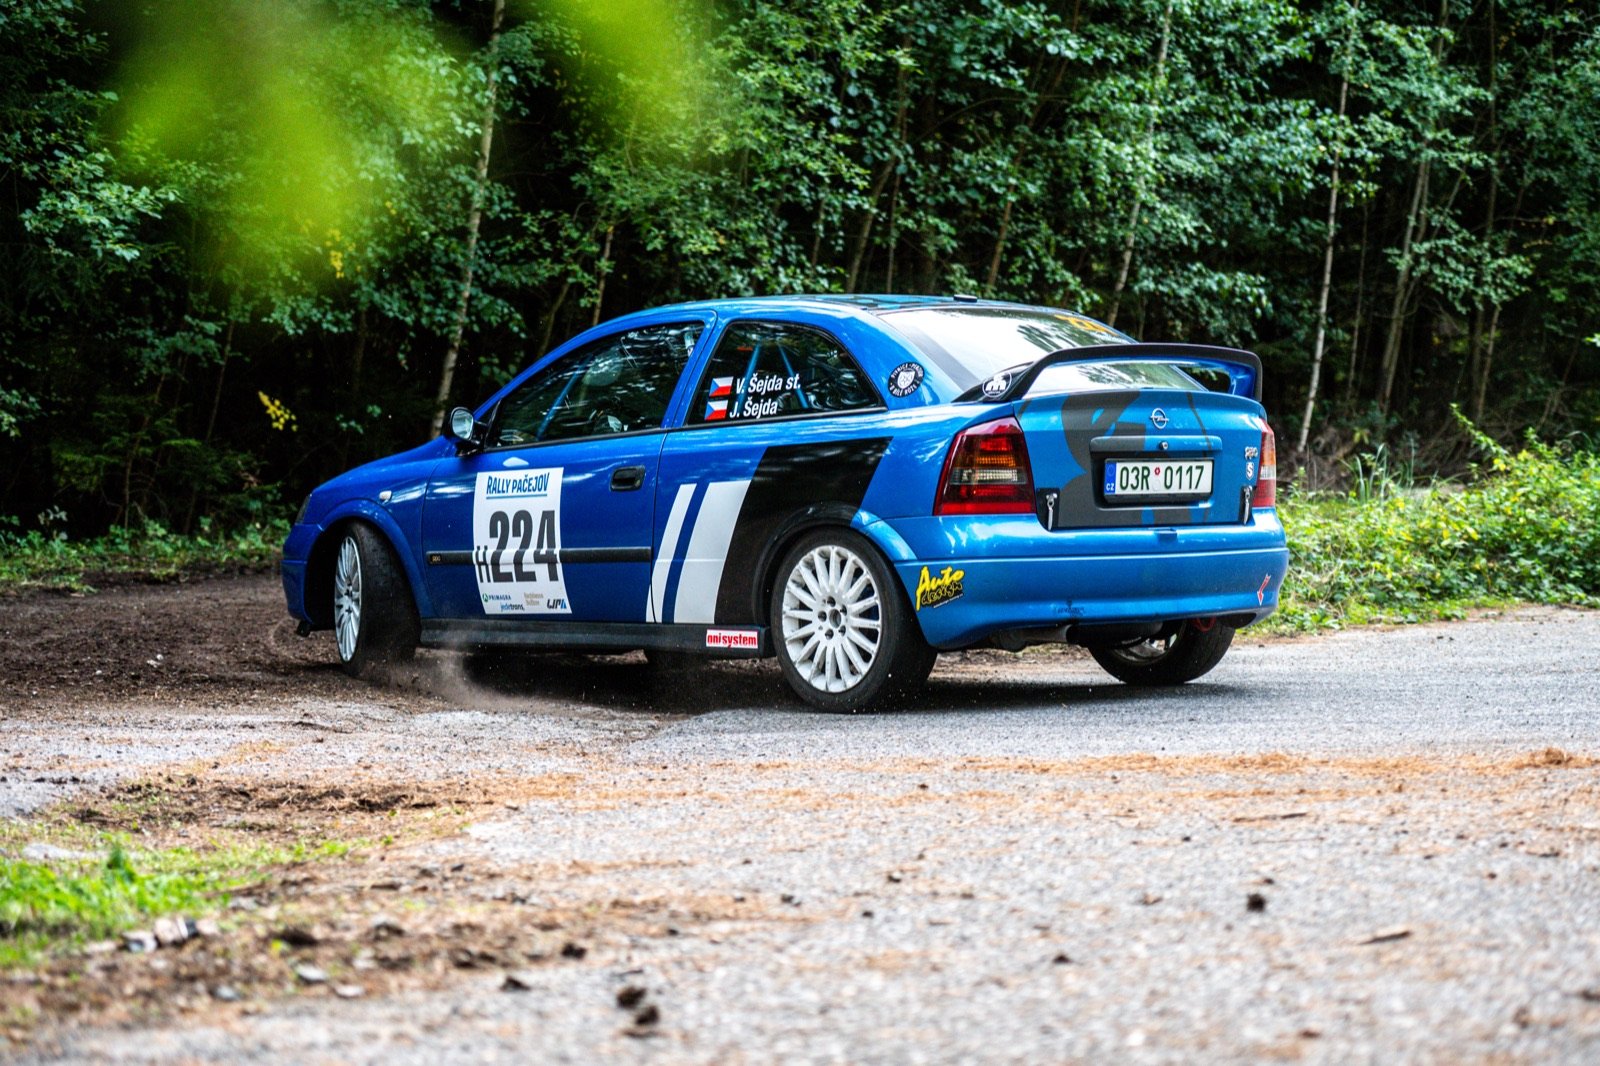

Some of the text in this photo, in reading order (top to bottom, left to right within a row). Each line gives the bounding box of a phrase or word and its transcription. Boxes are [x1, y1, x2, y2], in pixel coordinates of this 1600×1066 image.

[736, 373, 801, 396] V. Šejda st.
[730, 396, 778, 419] J. Šejda
[486, 472, 550, 495] RALLY PAČEJOV
[1105, 483, 1115, 491] CZ
[1120, 465, 1204, 491] 03R 0117
[916, 565, 965, 611] Auto
